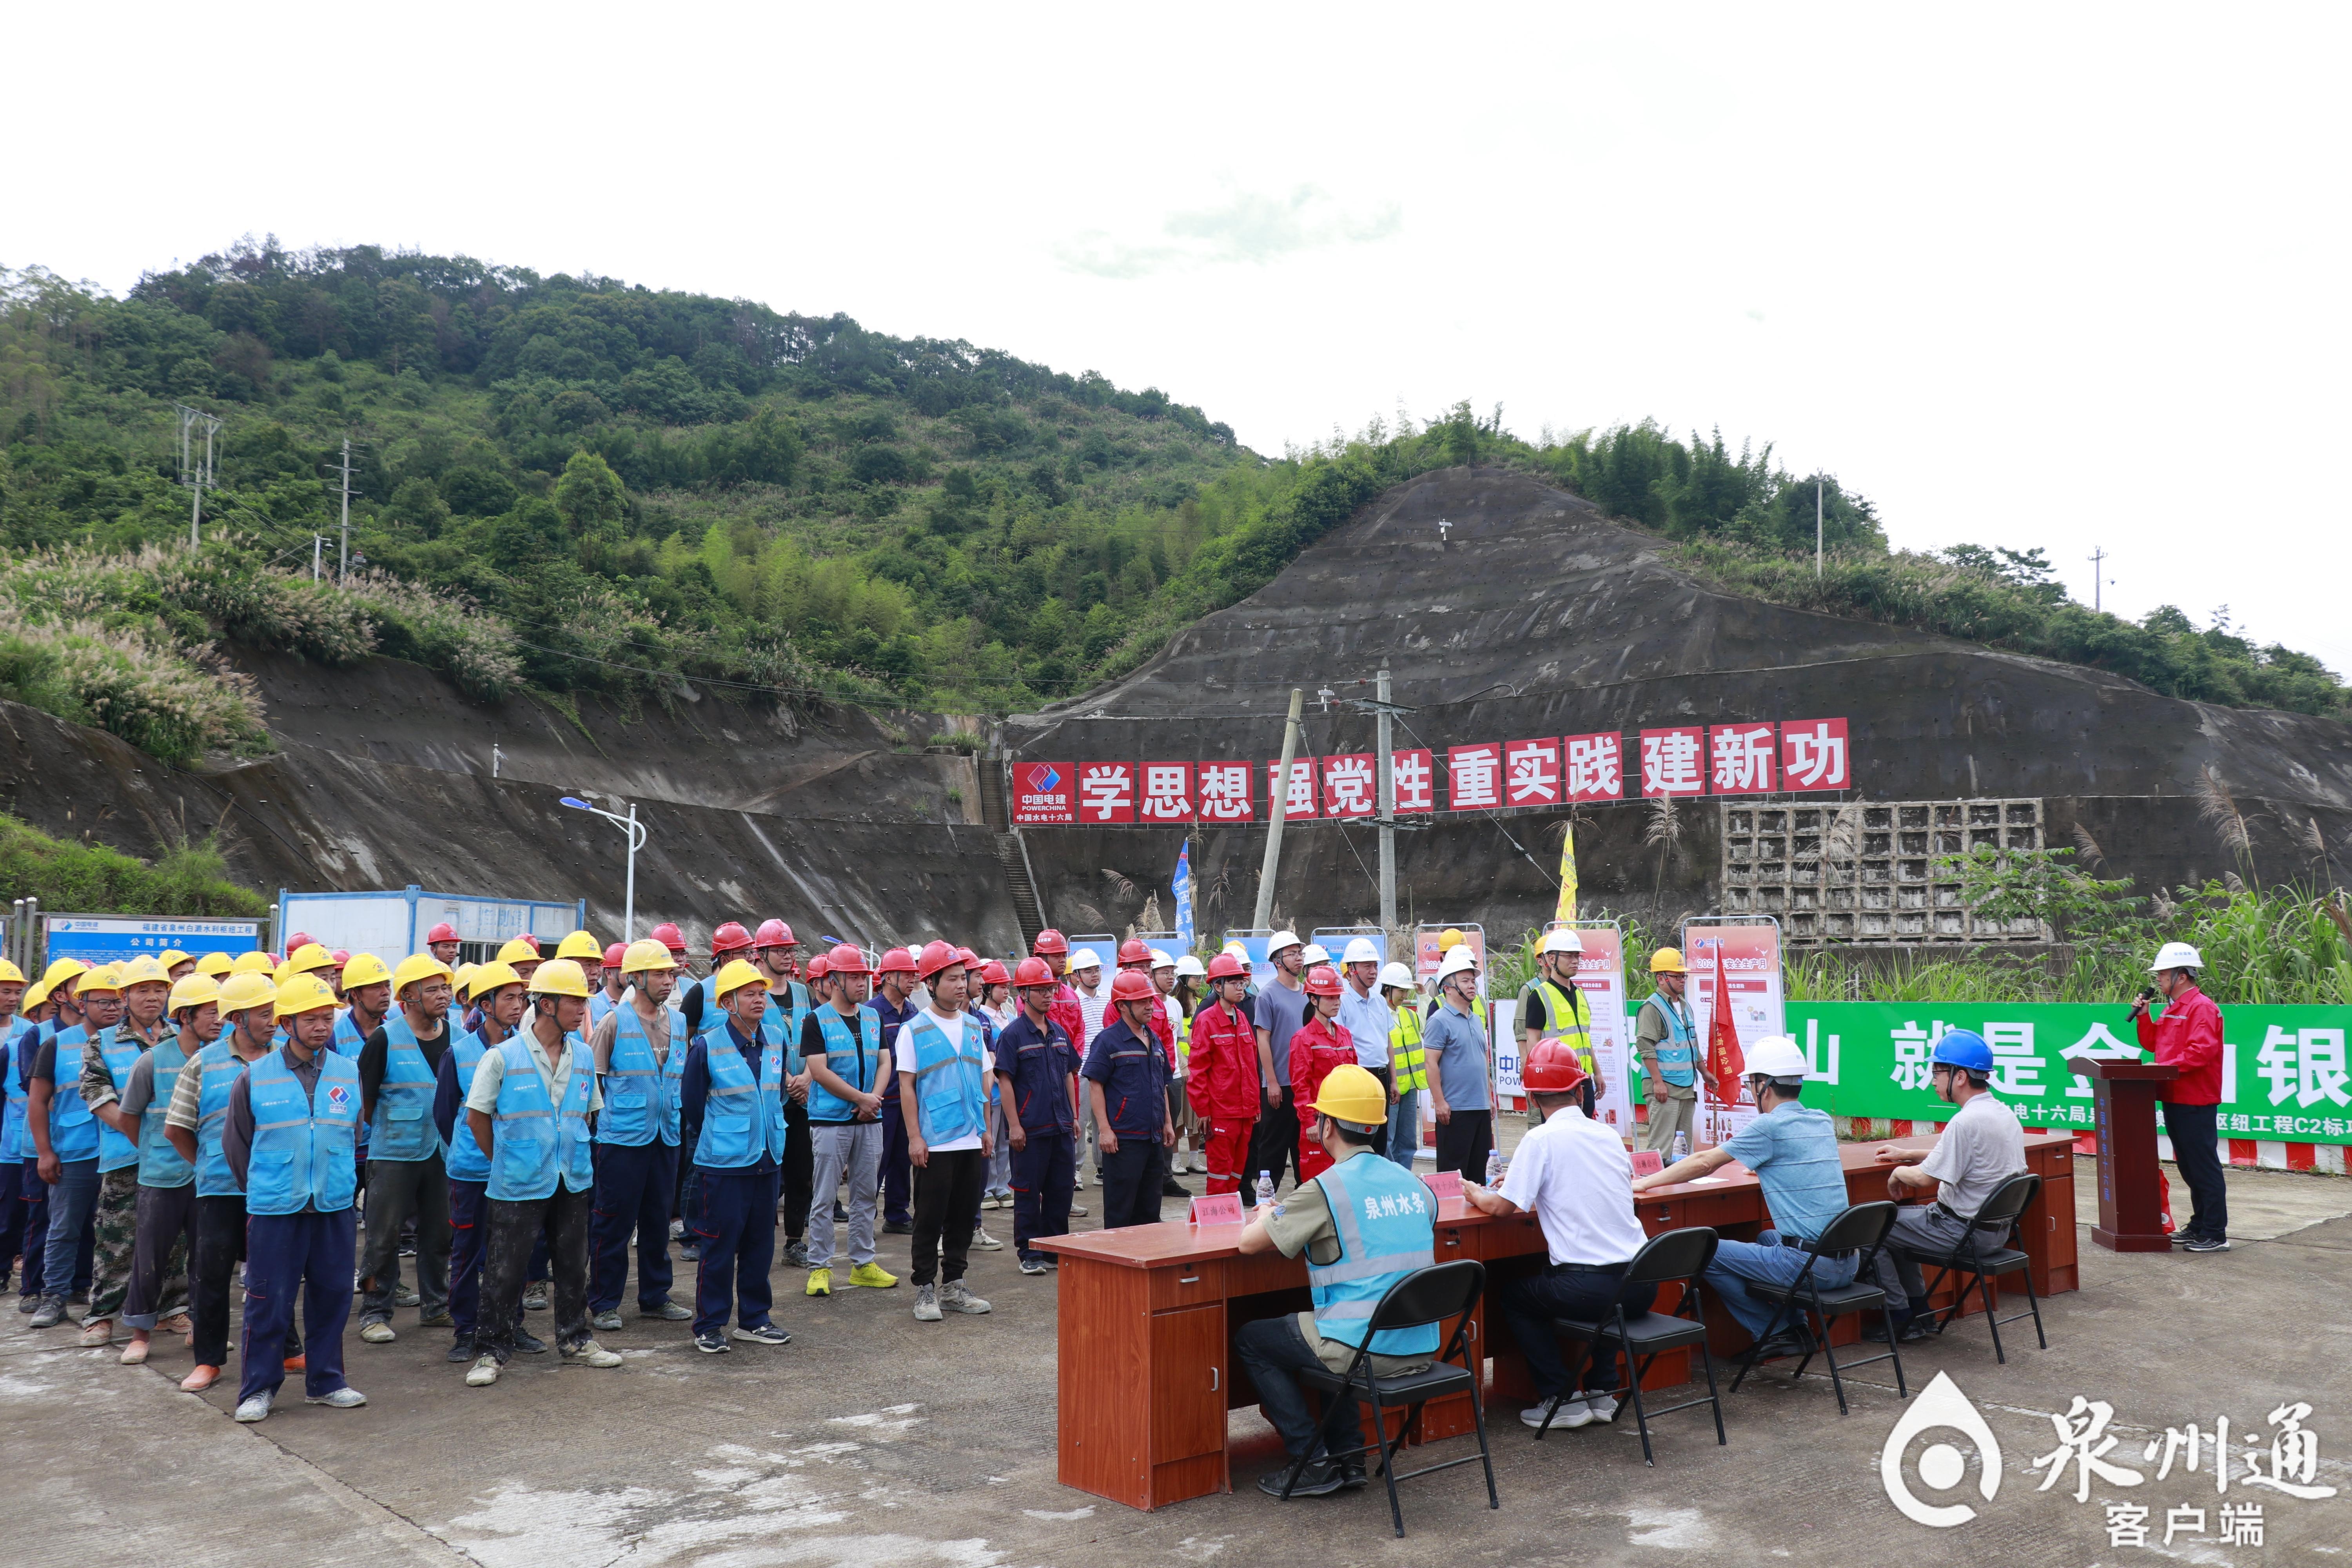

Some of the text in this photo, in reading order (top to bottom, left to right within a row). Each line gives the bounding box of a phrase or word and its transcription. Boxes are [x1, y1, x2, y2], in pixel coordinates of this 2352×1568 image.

[1083, 723, 1844, 818] 学思想 强党性 重实践 建新功
[1022, 794, 1066, 805] 中国电建
[1016, 813, 1072, 822] 中国水电十六局
[131, 938, 182, 947] 公司简介
[1716, 1033, 1733, 1075] 有限公司
[1890, 1020, 2351, 1109] 就是金银
[2099, 1096, 2110, 1202] 中国水电十六局
[1202, 1203, 1235, 1216] 江海公司
[1364, 1191, 1425, 1220] 泉州水务
